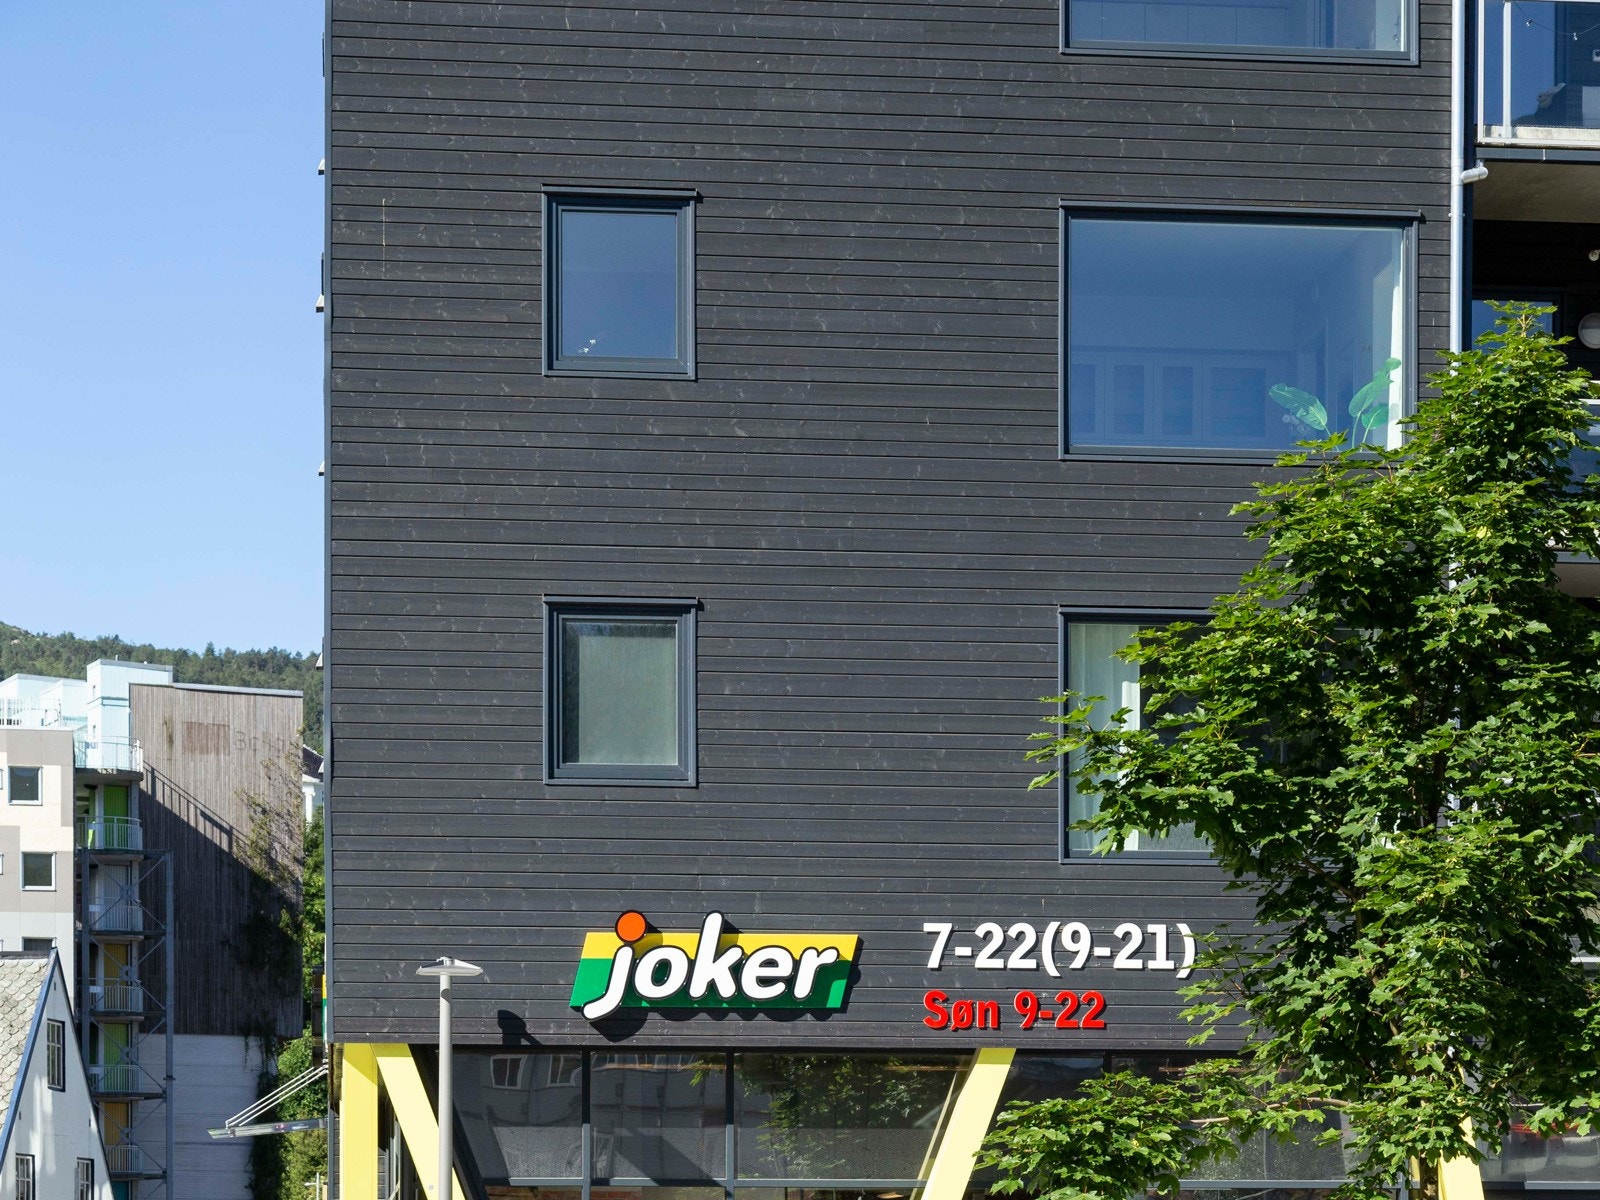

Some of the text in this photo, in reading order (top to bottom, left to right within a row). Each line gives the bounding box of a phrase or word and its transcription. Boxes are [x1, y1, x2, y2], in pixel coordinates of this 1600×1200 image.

[581, 909, 838, 1021] joker
[923, 922, 1196, 979] 7-22(9-21)
[923, 990, 1106, 1031] Søn 9-22
